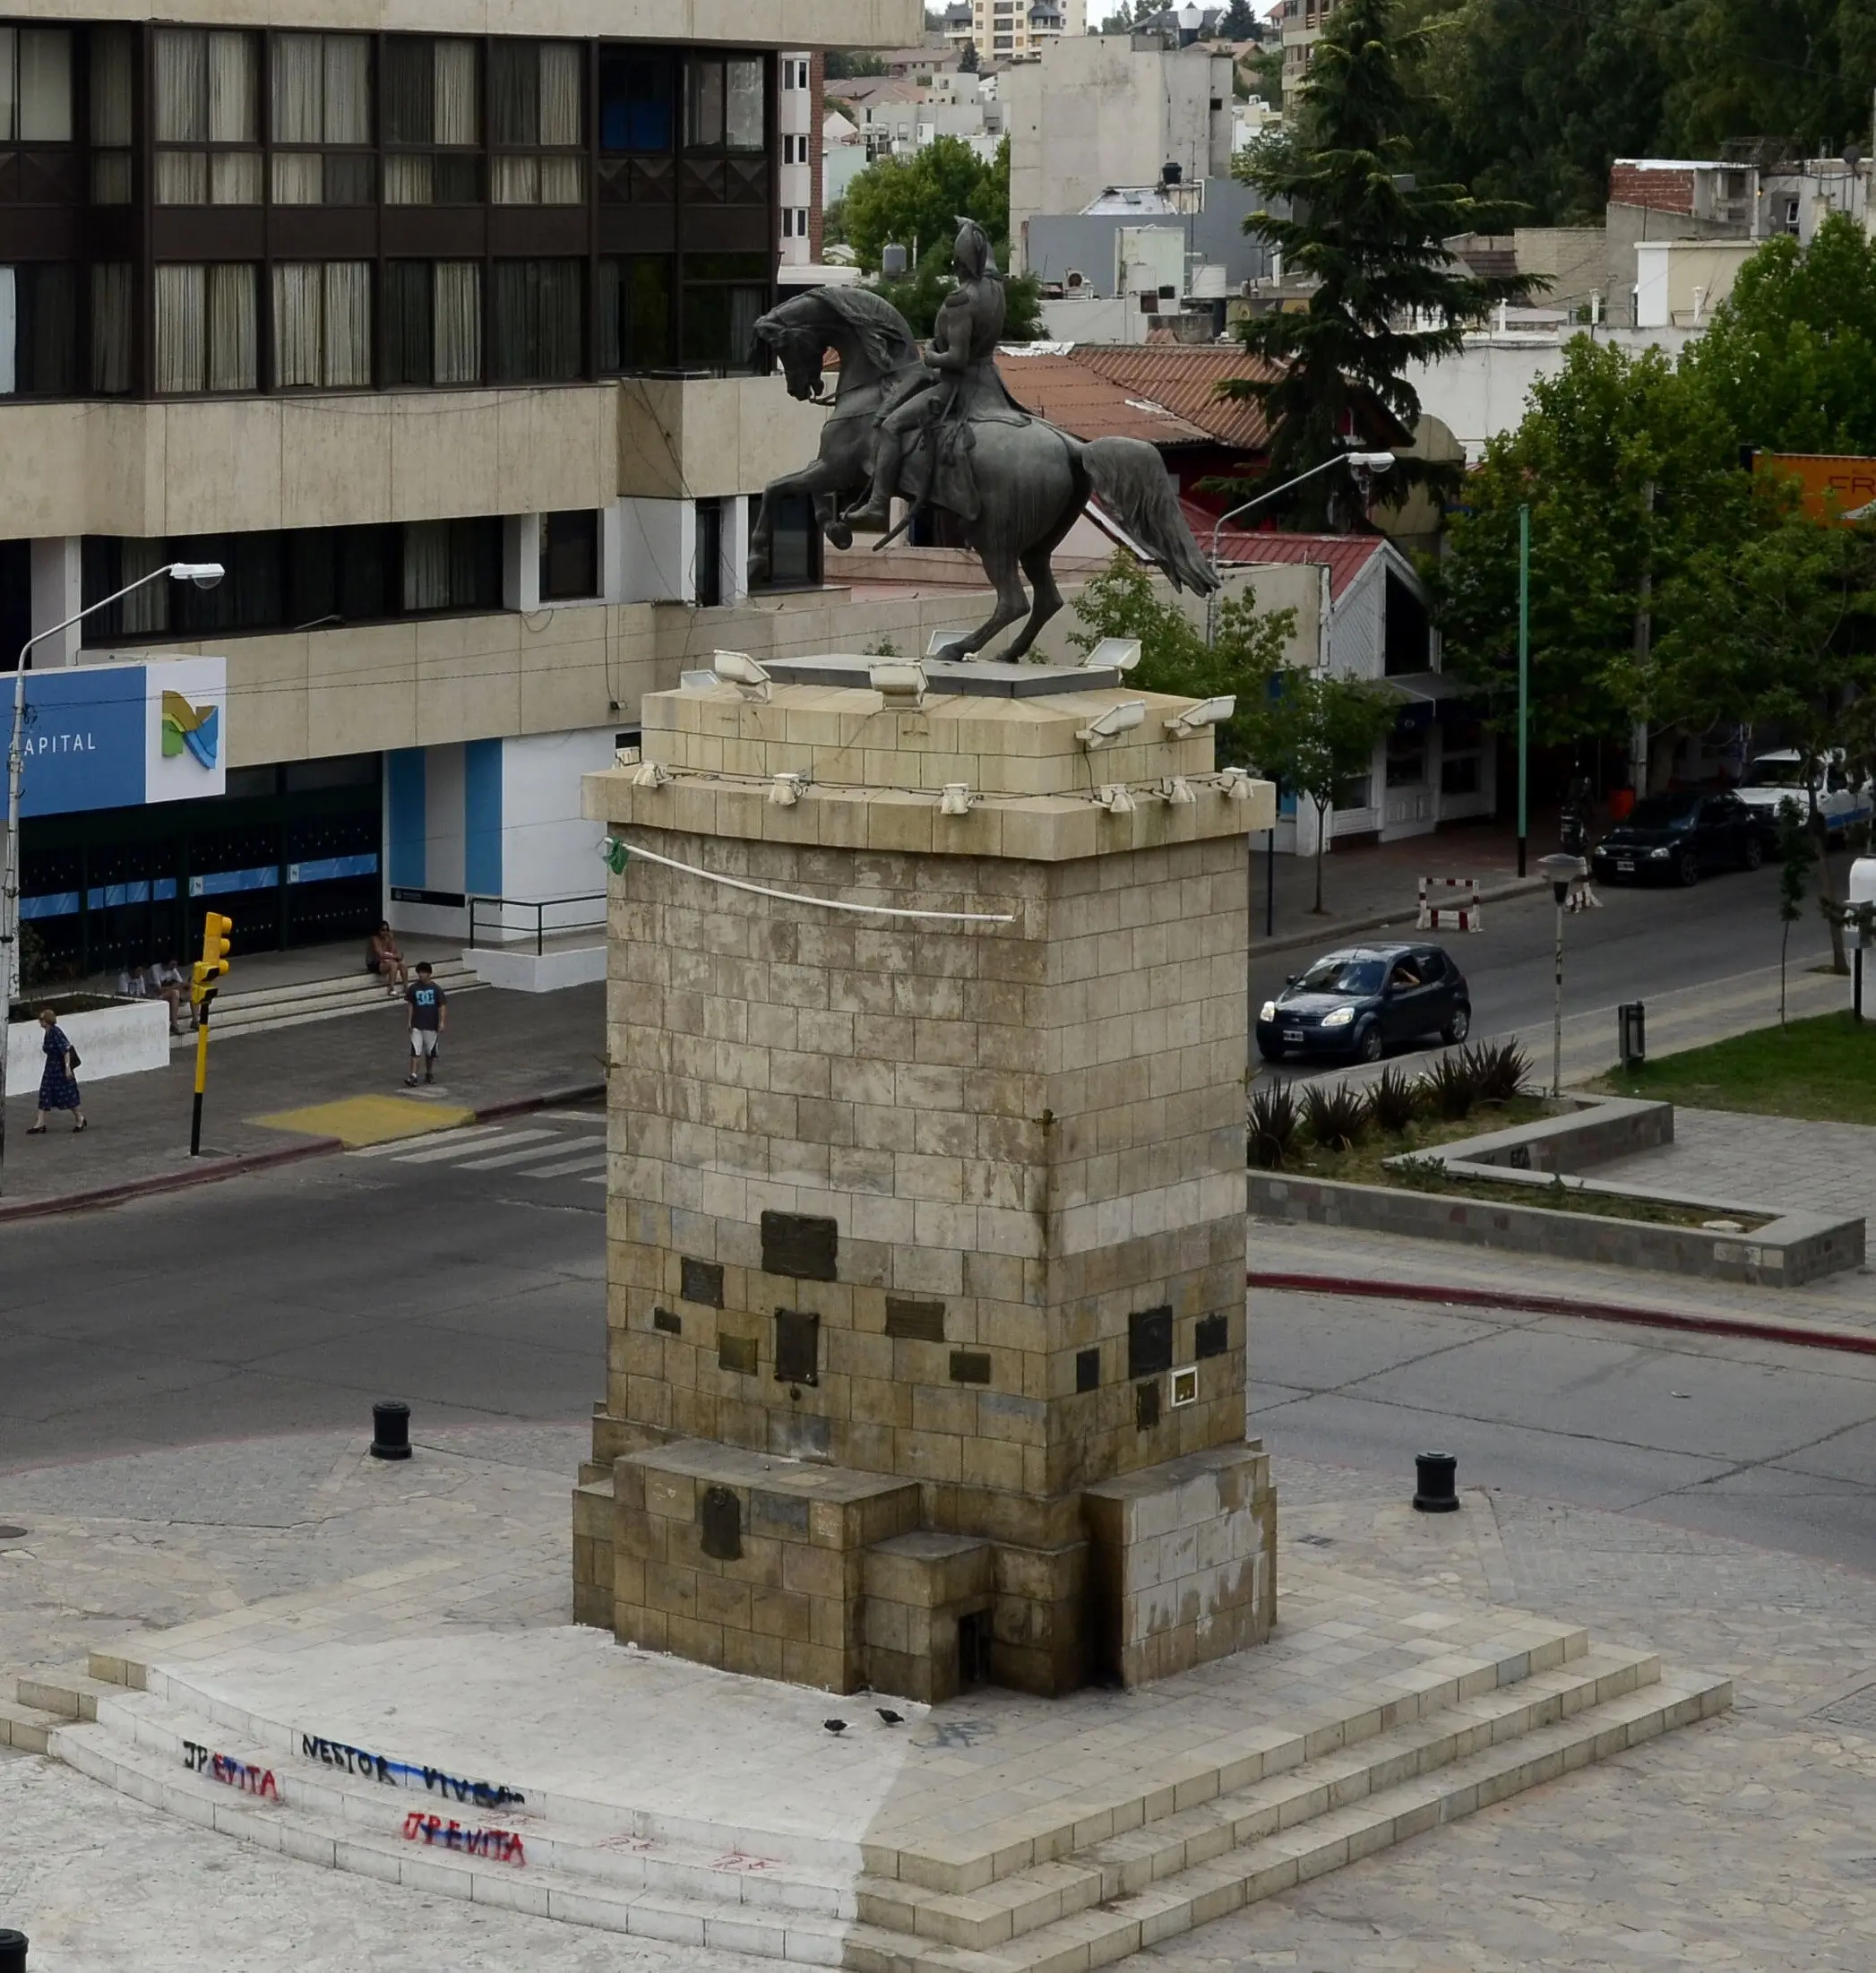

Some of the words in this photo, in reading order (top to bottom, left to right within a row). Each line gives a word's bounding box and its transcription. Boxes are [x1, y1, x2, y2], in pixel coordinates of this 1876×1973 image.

[9, 732, 96, 756] APITAL
[183, 1741, 208, 1773] JP
[211, 1752, 282, 1802] EVITA
[302, 1733, 399, 1788] NESTOR
